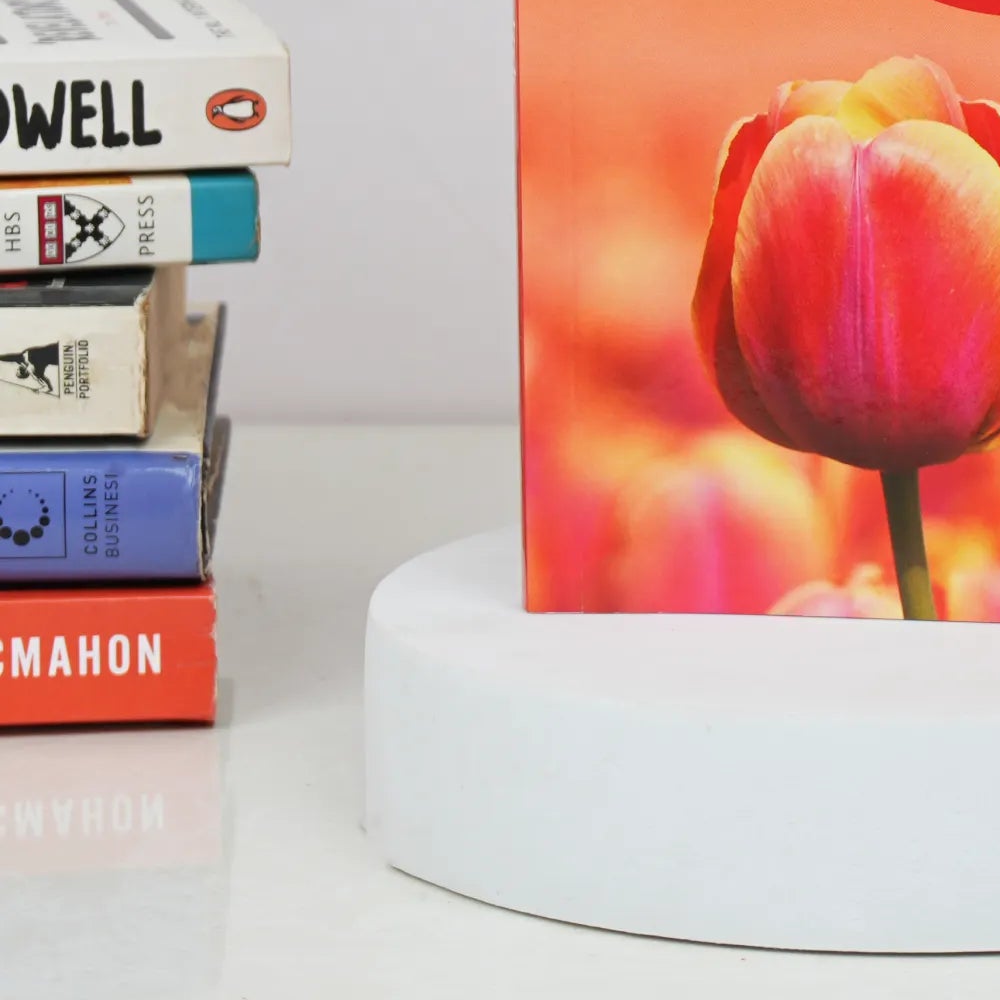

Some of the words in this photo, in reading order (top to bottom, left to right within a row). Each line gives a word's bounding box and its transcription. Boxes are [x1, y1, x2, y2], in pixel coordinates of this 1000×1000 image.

[4, 211, 22, 252] HBS
[137, 195, 155, 257] PRESS
[62, 344, 75, 396] PENGUIN
[78, 339, 90, 400] PORTFOLIO
[83, 474, 99, 556] COLLINS
[0, 633, 162, 679] MAHON
